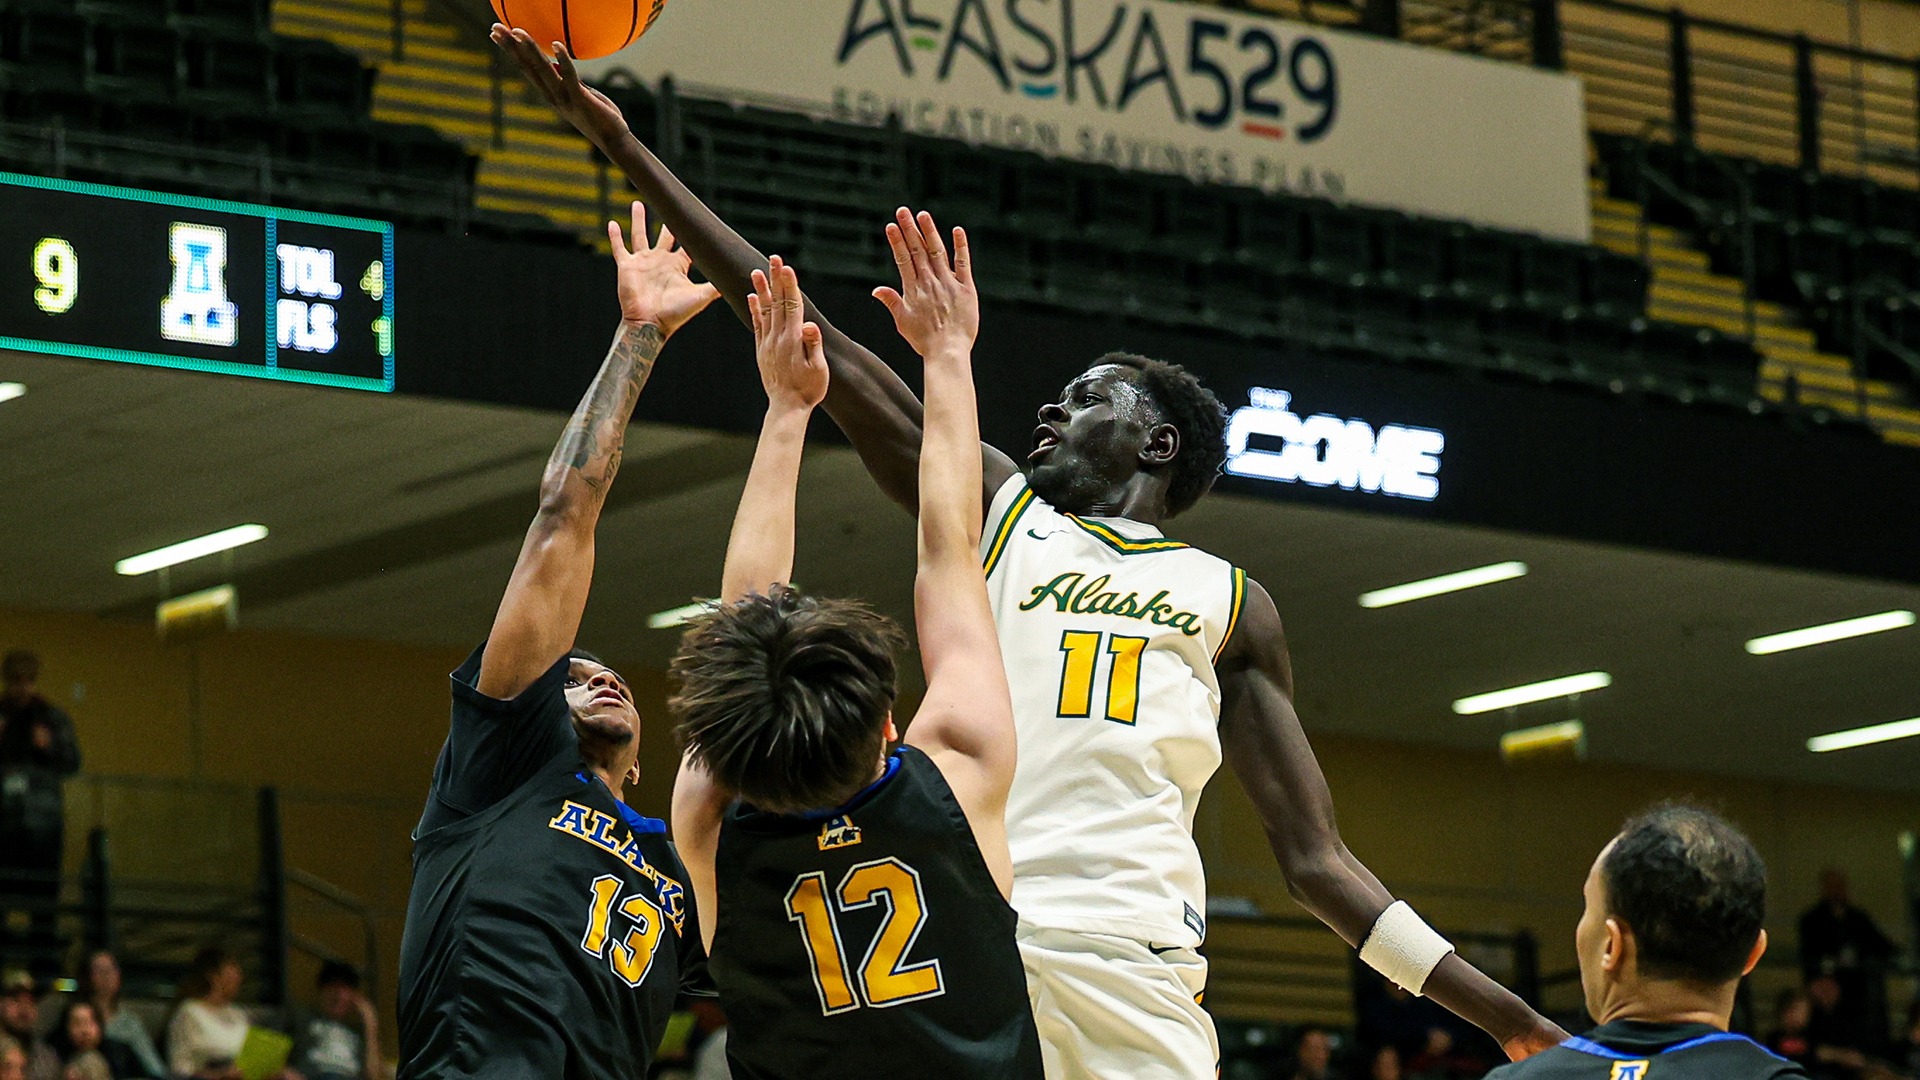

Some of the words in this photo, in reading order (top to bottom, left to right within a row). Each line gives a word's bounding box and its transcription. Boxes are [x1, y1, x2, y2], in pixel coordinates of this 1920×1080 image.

[33, 236, 79, 314] 9
[276, 243, 342, 300] TOL
[276, 298, 339, 353] FLS
[1019, 572, 1202, 636] Alaska
[1055, 629, 1150, 727] 11
[581, 873, 666, 989] 13
[783, 856, 946, 1017] 12
